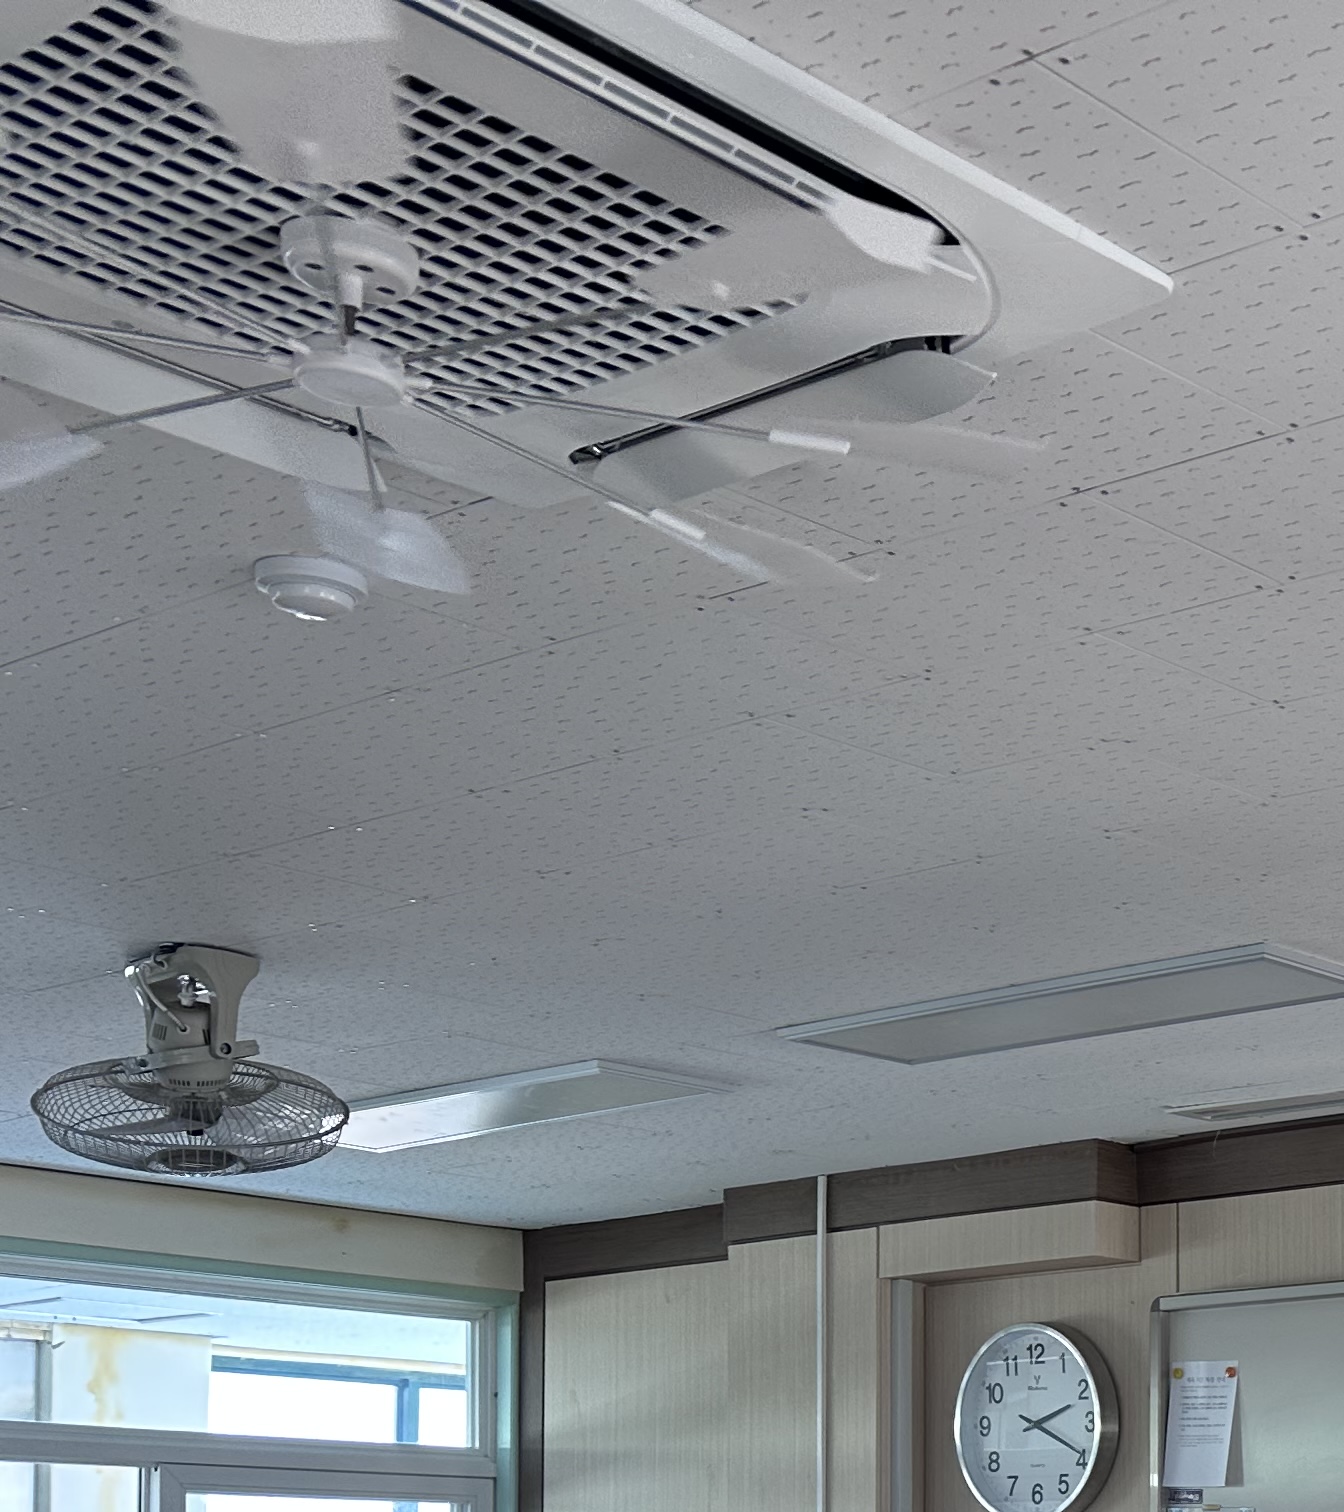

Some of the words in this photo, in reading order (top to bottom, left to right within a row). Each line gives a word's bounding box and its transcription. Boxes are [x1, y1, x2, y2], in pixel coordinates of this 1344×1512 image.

[1026, 1343, 1045, 1364] 12
[1059, 1352, 1066, 1373] 1
[1003, 1355, 1018, 1376] 11
[986, 1382, 1004, 1404] 10
[1078, 1379, 1089, 1400] 2
[979, 1415, 991, 1437] 9
[1084, 1411, 1094, 1432] 3
[988, 1451, 1000, 1472] 8
[1075, 1449, 1088, 1470] 4
[1007, 1475, 1019, 1496] 7
[1031, 1483, 1043, 1504] 6
[1058, 1474, 1069, 1494] 5
